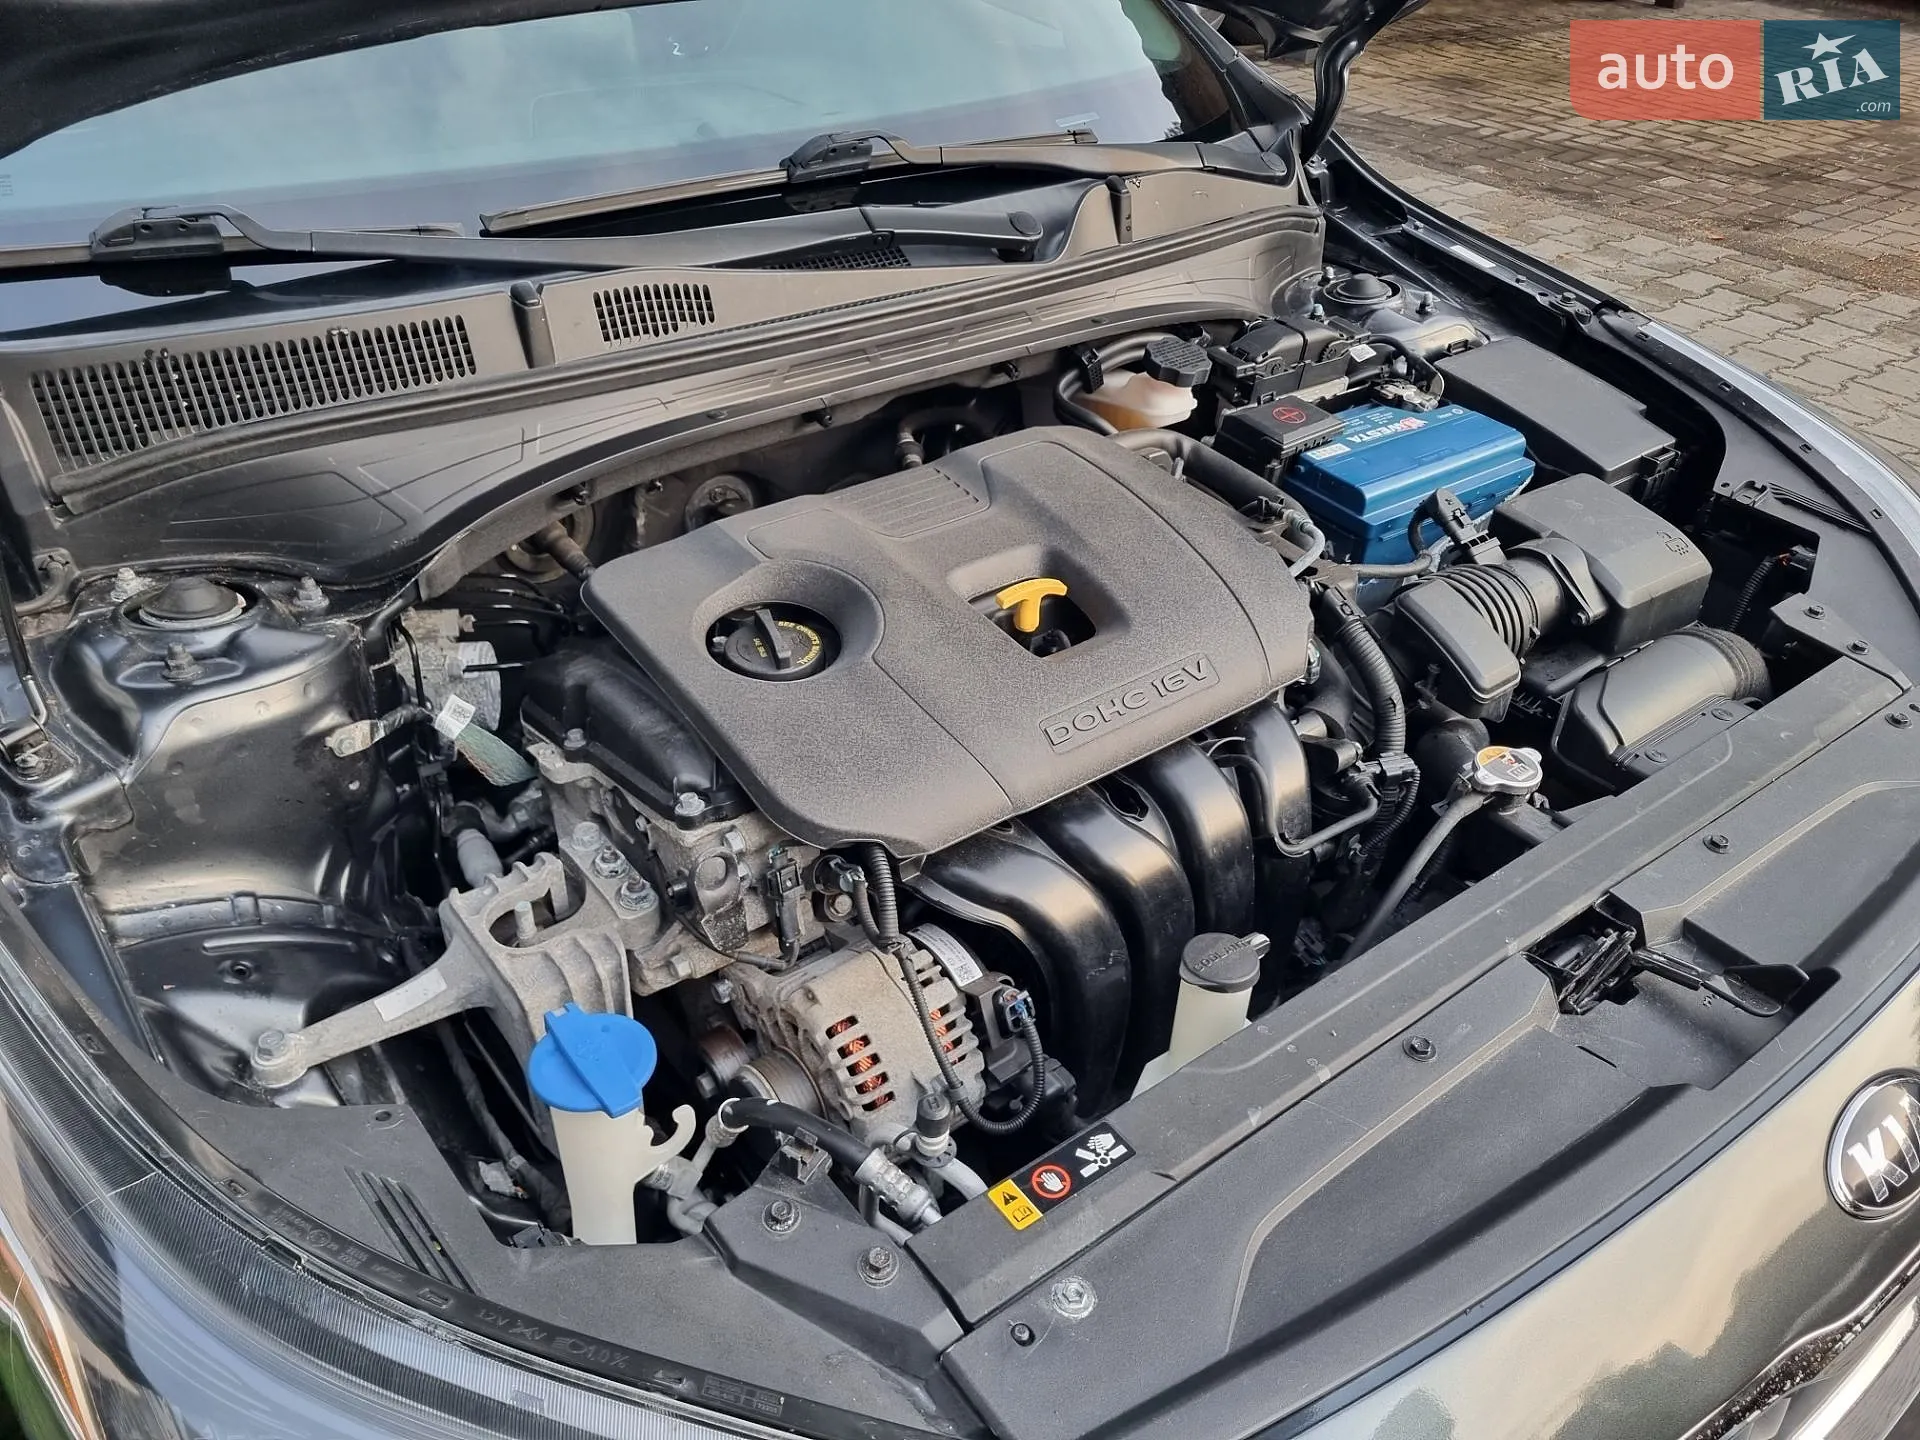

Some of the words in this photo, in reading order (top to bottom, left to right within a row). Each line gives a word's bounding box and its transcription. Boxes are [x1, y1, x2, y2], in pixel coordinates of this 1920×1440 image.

[796, 645, 820, 665] MANUAL
[1044, 688, 1151, 746] DOHC
[1151, 659, 1208, 697] 16V
